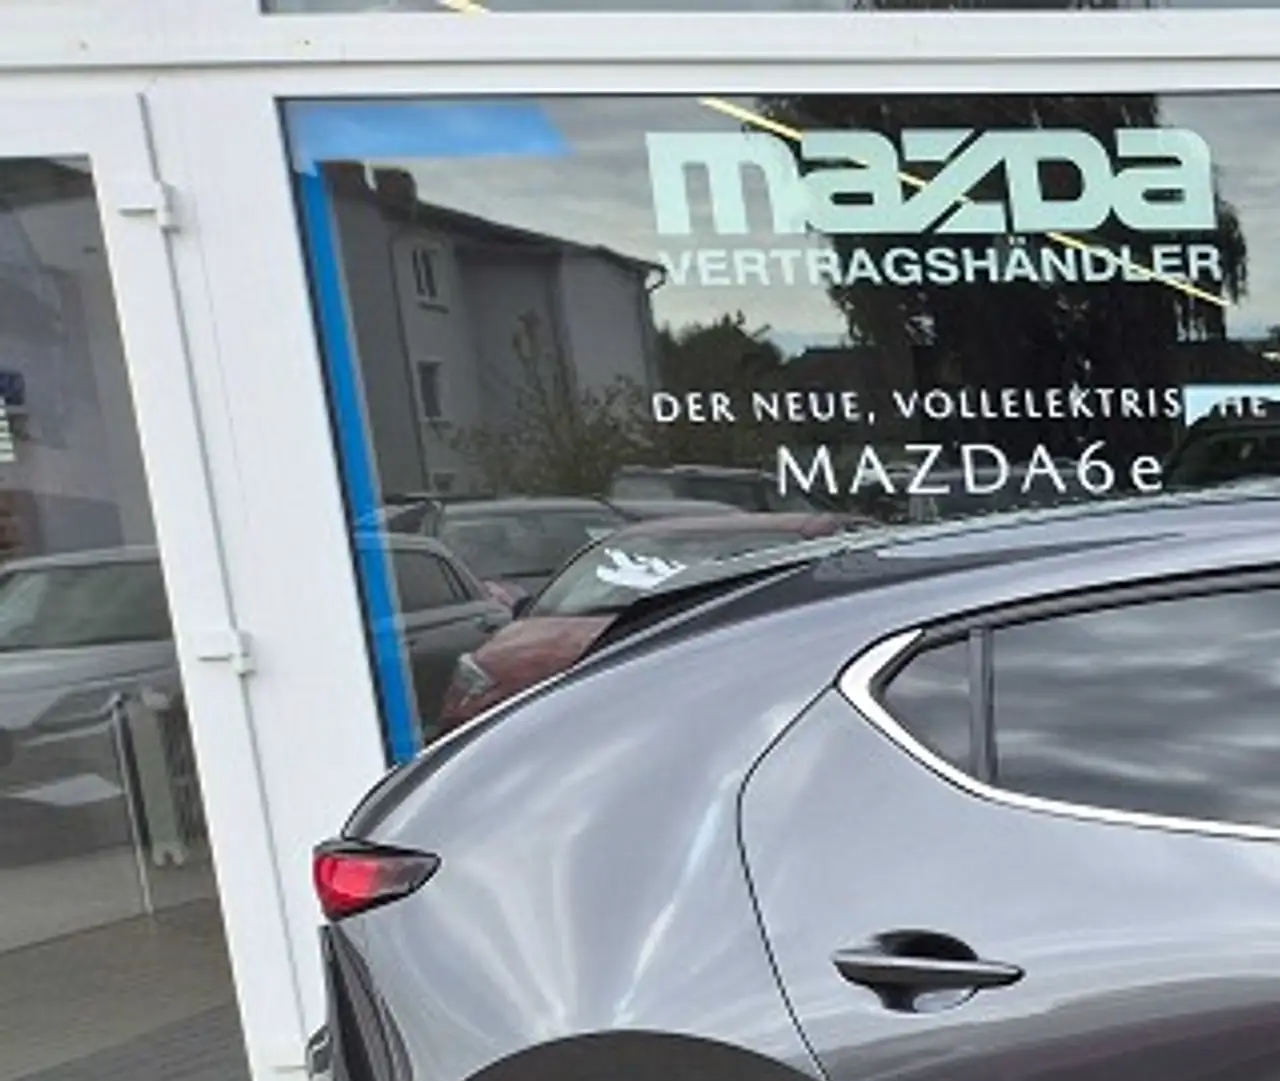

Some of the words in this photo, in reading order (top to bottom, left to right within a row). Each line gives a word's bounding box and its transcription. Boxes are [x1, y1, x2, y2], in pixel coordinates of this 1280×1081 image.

[656, 236, 1223, 286] VERTRAGSHÄNDLER
[653, 391, 735, 423] DER
[752, 389, 876, 425] NEUE,
